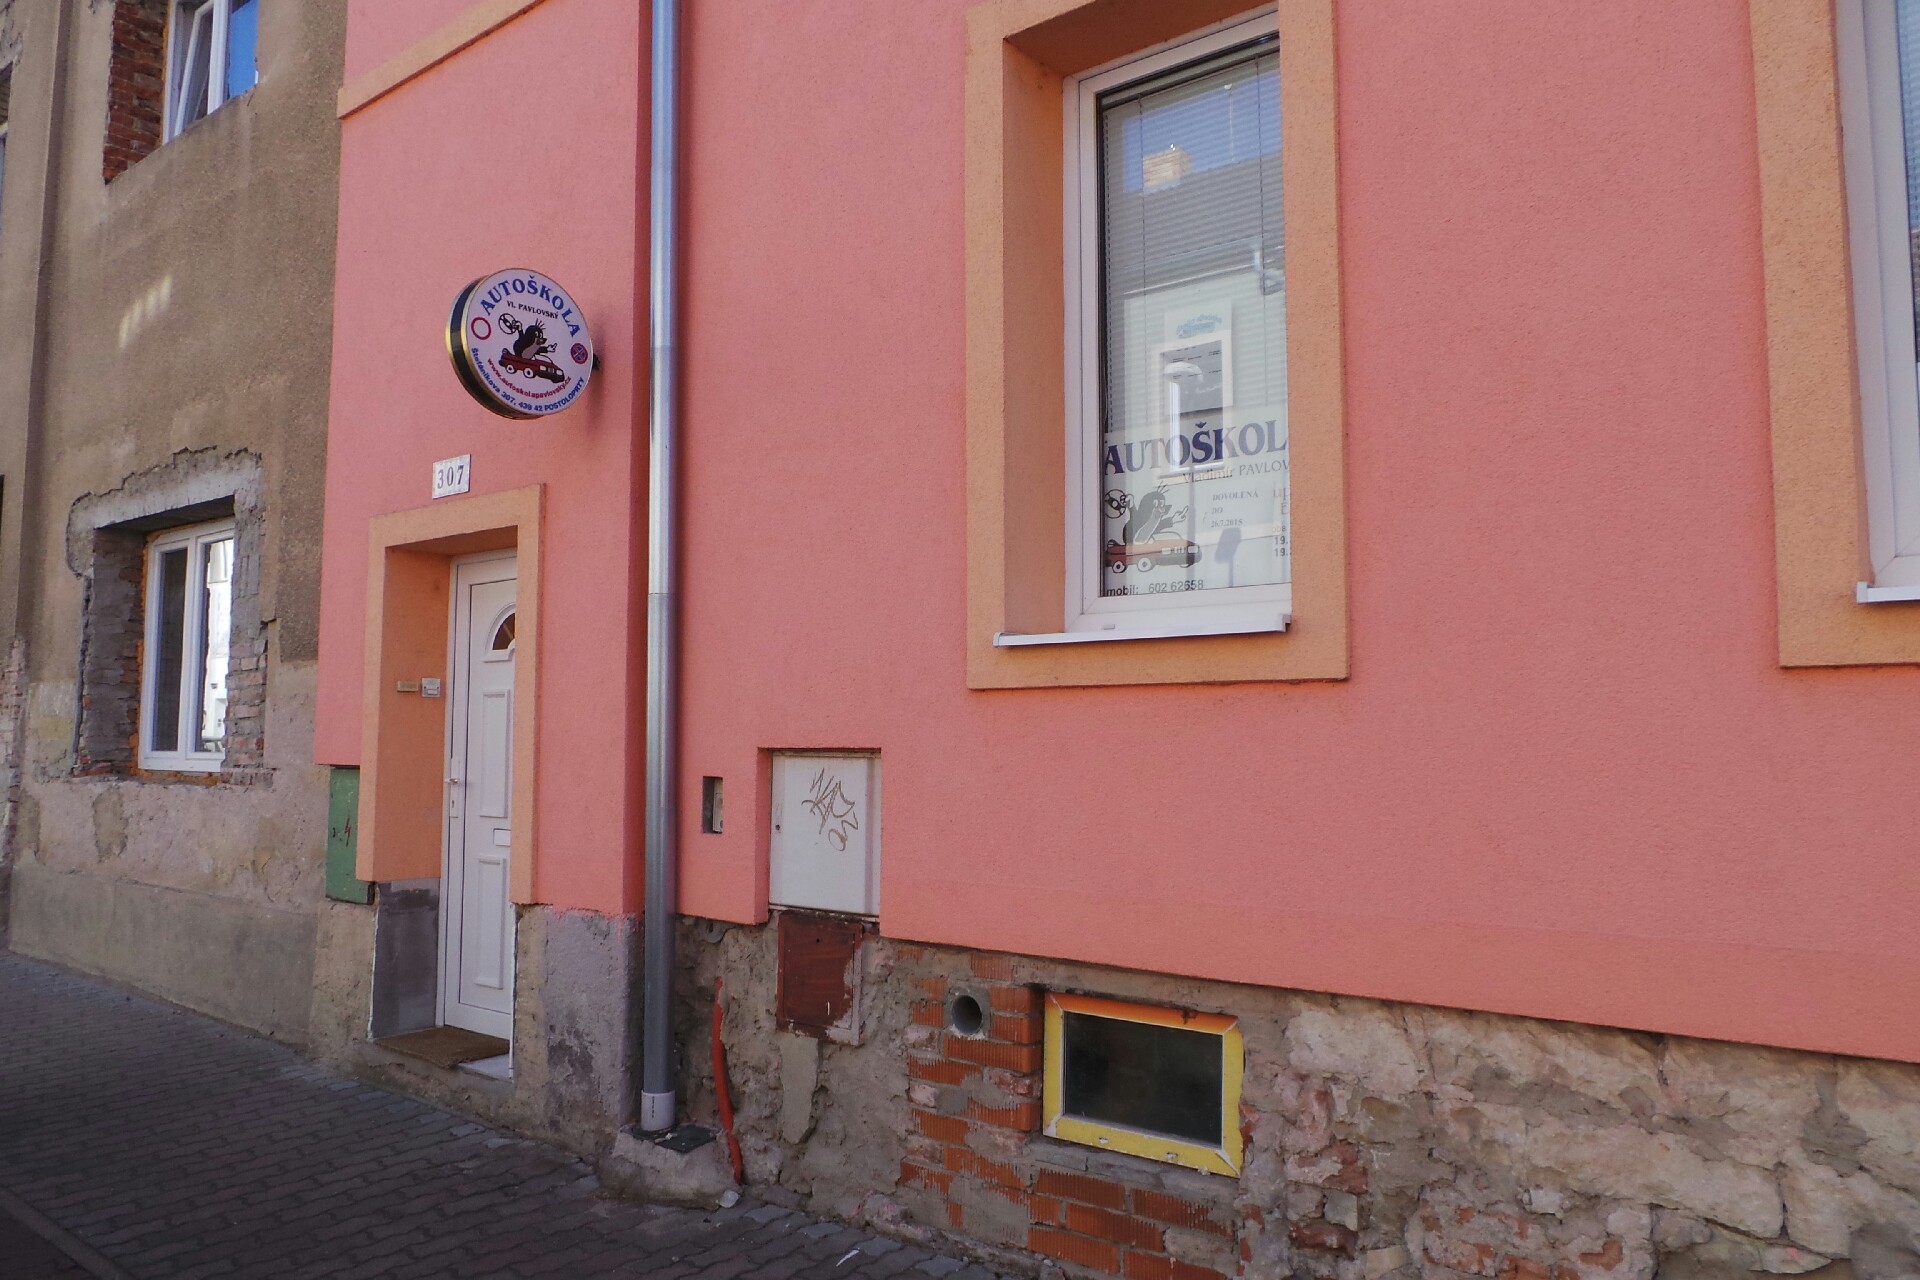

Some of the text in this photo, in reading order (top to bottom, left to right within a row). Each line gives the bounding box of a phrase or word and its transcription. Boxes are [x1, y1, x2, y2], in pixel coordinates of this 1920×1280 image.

[480, 275, 581, 338] AUTOŠKOLA
[518, 303, 559, 320] PAVLOVSKÝ
[471, 347, 501, 393] Štefánikova
[518, 400, 532, 411] 439
[534, 403, 543, 412] 42
[544, 377, 585, 412] POSTOLOPRTY
[487, 357, 572, 399] www.autoskolapavlovsky.cz
[437, 464, 464, 489] 307
[1212, 488, 1259, 501] DOVOLENÁ
[1212, 506, 1224, 515] DO
[1106, 584, 1139, 597] mobil:
[1148, 582, 1168, 593] 602
